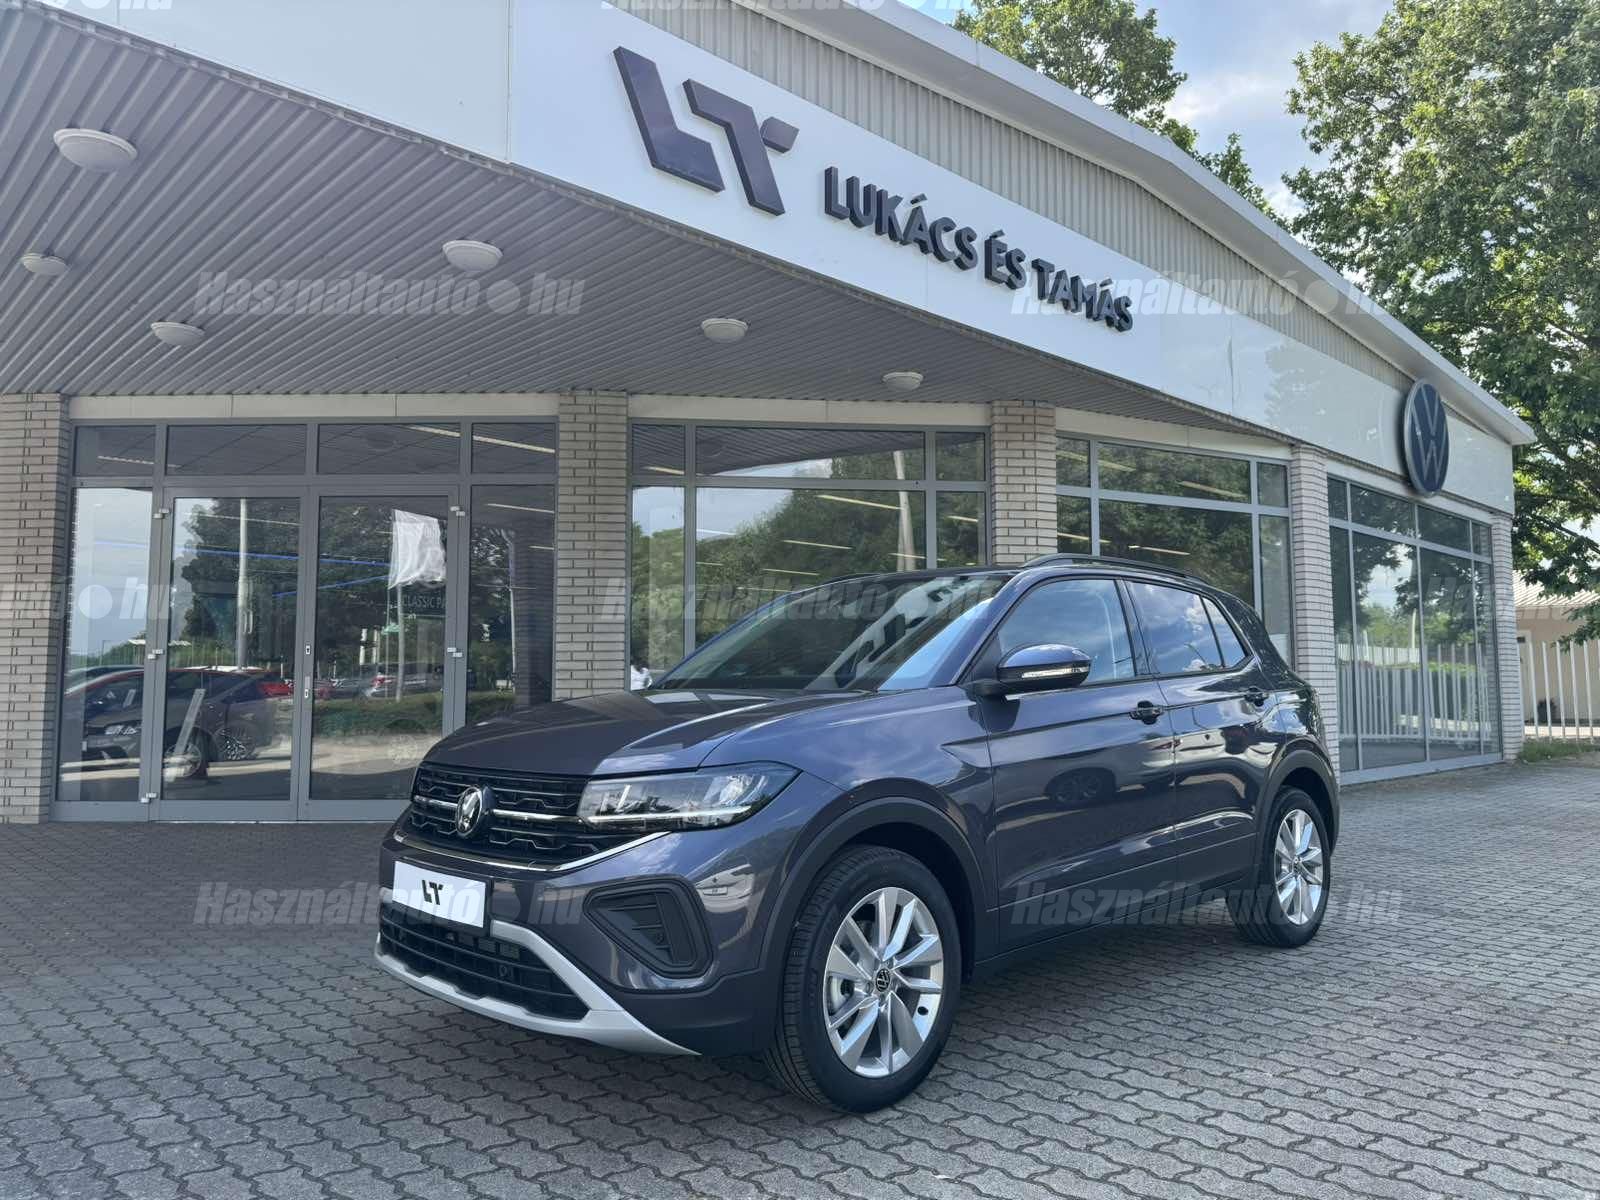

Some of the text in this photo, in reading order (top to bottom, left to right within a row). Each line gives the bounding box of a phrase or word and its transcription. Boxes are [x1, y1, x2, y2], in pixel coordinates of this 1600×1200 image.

[824, 166, 1133, 333] LUKÁCS ÉS TAMÁS
